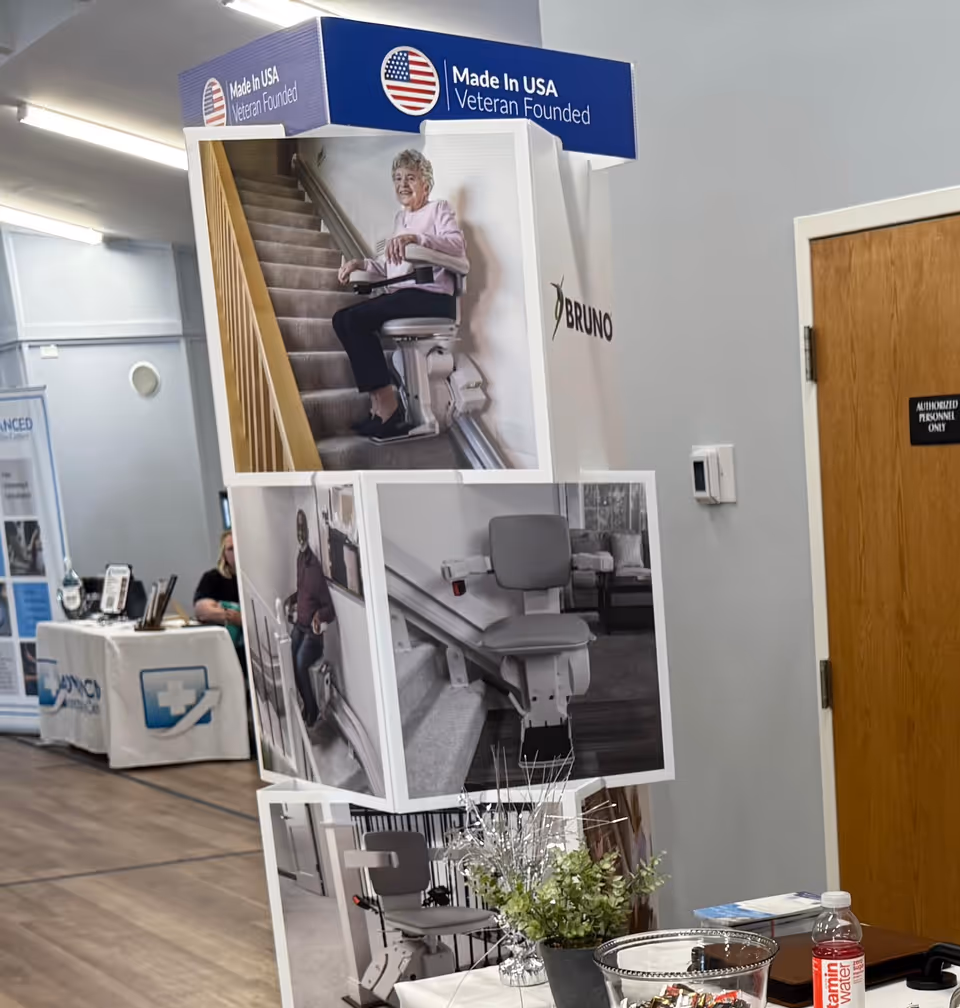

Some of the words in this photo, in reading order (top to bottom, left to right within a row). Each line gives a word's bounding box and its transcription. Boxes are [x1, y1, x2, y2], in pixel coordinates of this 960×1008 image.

[229, 77, 251, 100] Made
[252, 73, 260, 91] In
[260, 65, 280, 87] USA
[452, 65, 499, 89] Made
[504, 73, 519, 92] In
[523, 75, 559, 97] USA
[232, 99, 261, 123] Veteran
[262, 80, 298, 113] Founded
[454, 87, 519, 116] Veteran
[523, 97, 591, 125] Founded
[565, 297, 613, 342] BRUNO
[916, 399, 959, 412] AUTHORIZED
[918, 410, 955, 423] PERSONNEL
[928, 422, 946, 432] ONLY
[839, 962, 852, 1005] water
